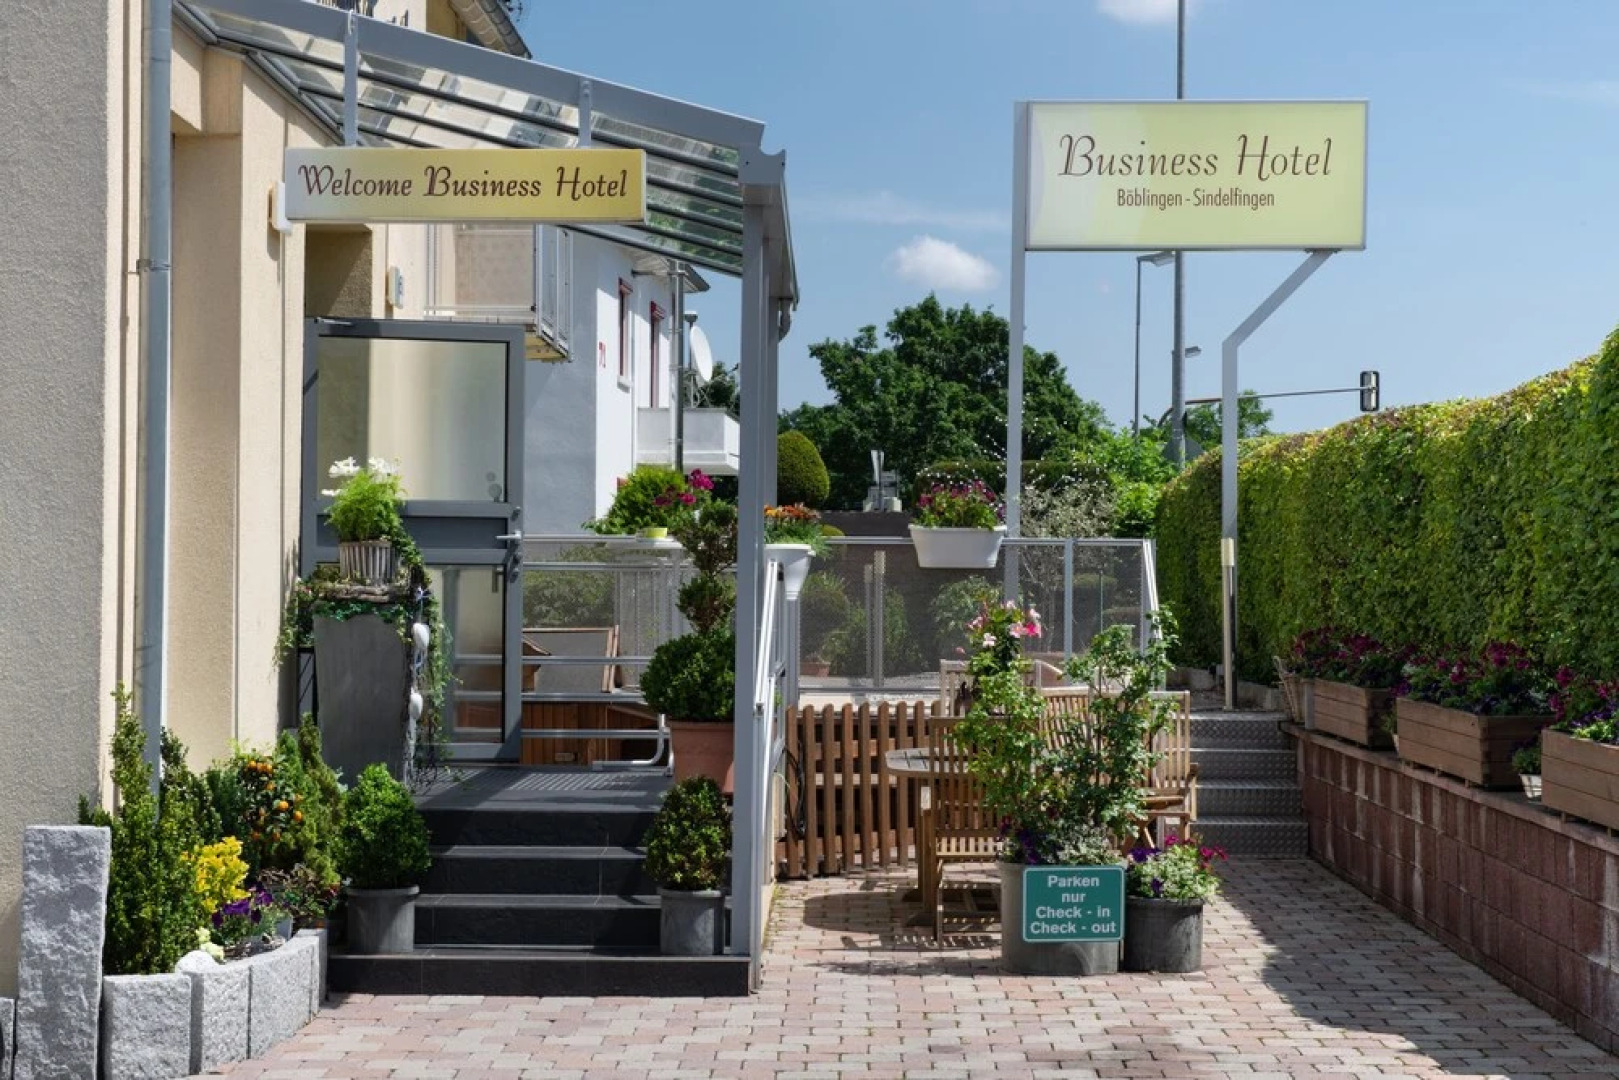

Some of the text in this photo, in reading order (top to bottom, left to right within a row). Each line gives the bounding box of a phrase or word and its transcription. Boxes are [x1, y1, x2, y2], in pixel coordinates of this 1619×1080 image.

[1058, 134, 1332, 182] Business Hotel
[298, 165, 628, 201] Welcome Business Hotel
[1117, 188, 1183, 211] Böblingen
[1193, 188, 1275, 211] Sindelfingen
[1047, 875, 1100, 888] Parken
[1061, 892, 1087, 903] nur
[1035, 906, 1082, 919] Check
[1097, 905, 1110, 918] in
[1029, 921, 1077, 934] Check
[1091, 921, 1117, 934] out
